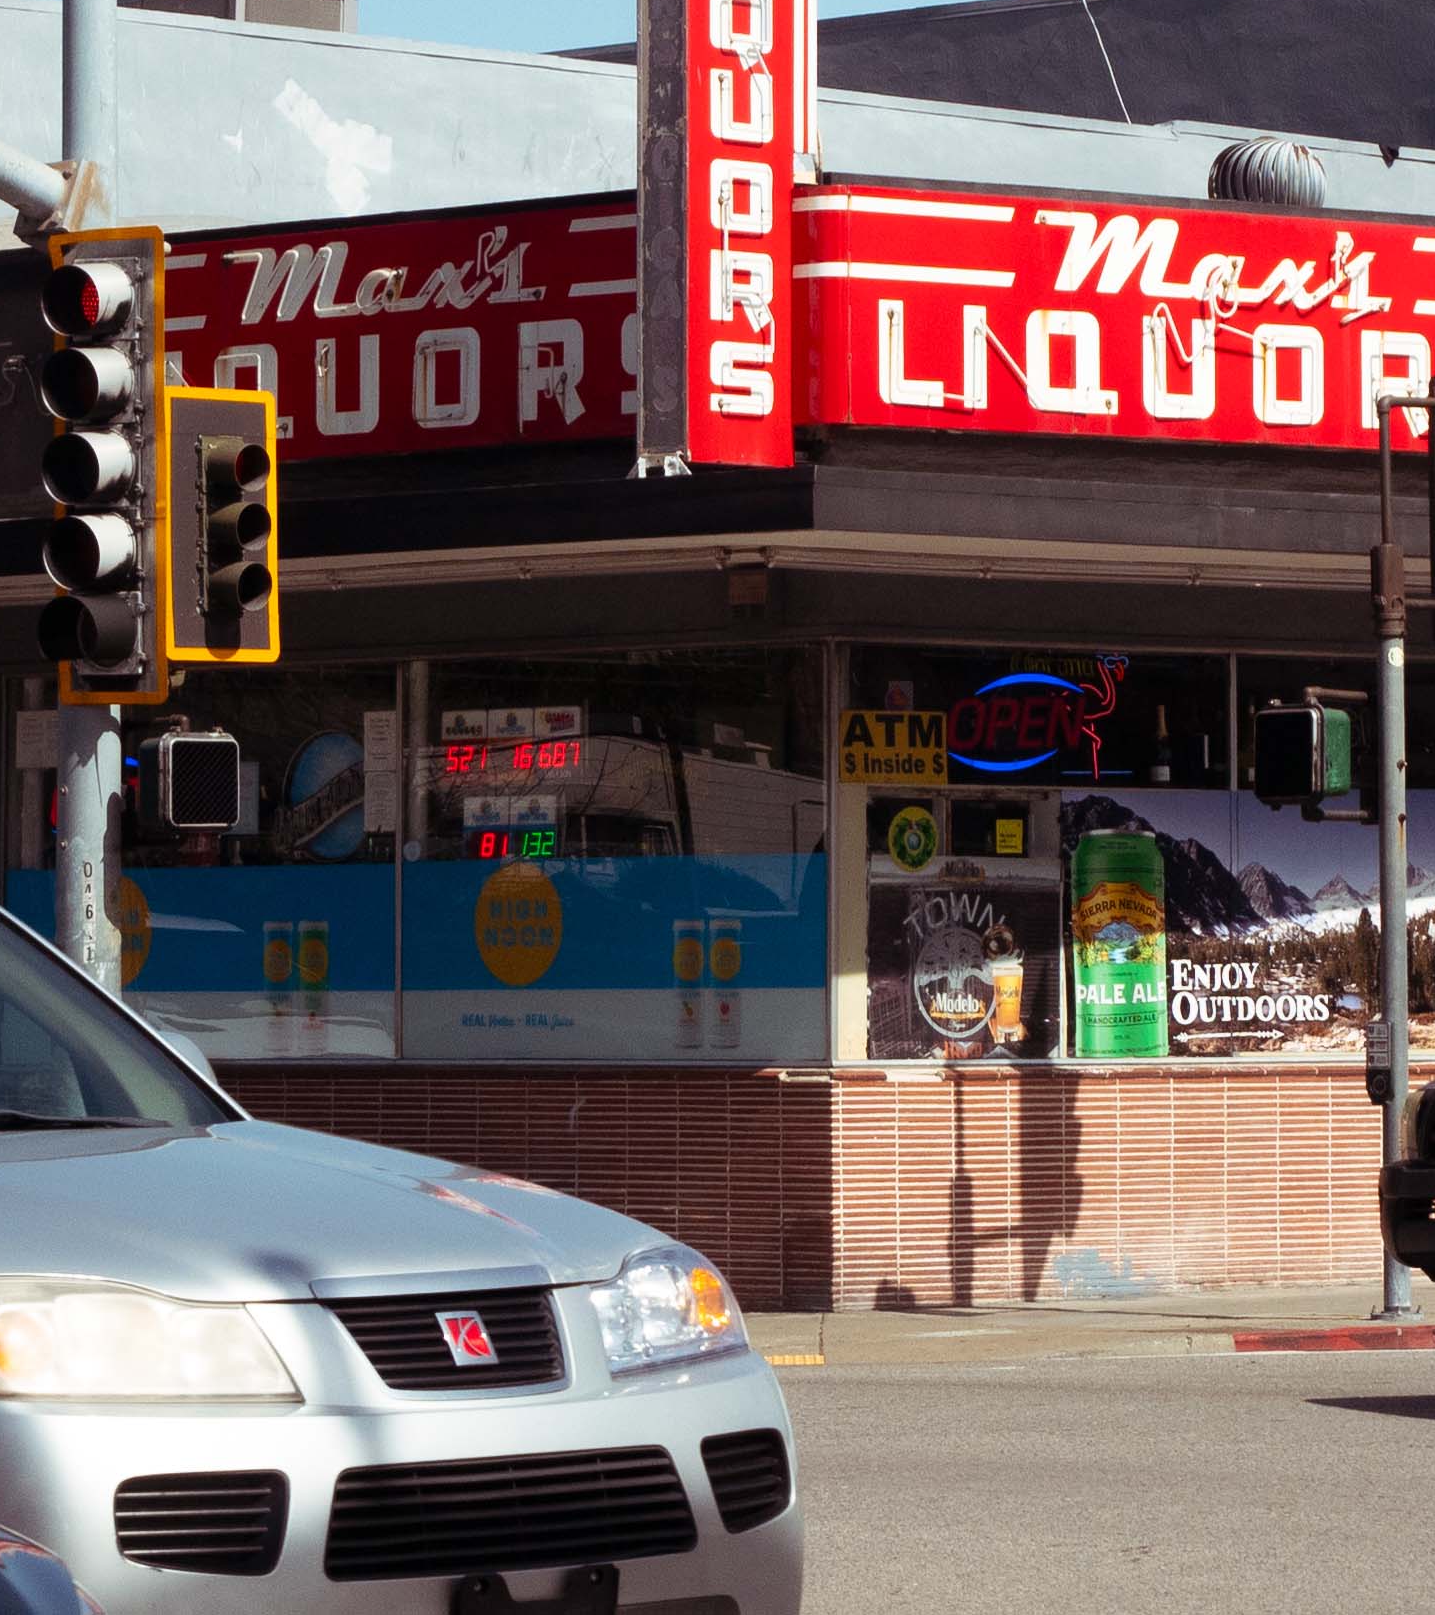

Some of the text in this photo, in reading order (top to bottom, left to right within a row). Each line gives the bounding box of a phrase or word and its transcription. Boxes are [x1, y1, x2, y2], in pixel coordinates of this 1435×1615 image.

[222, 225, 547, 325] Max's
[1034, 208, 1392, 321] Max's
[843, 714, 944, 748] ATM
[948, 696, 1087, 752] OPEN
[864, 751, 926, 775] Inside
[520, 831, 557, 858] 132
[1080, 897, 1157, 921] SIERRA NEVADA
[1171, 959, 1259, 992] ENJOY
[936, 992, 980, 1014] Modelo
[1075, 981, 1166, 1005] PALE ALE
[1171, 991, 1330, 1025] OUTDOORS
